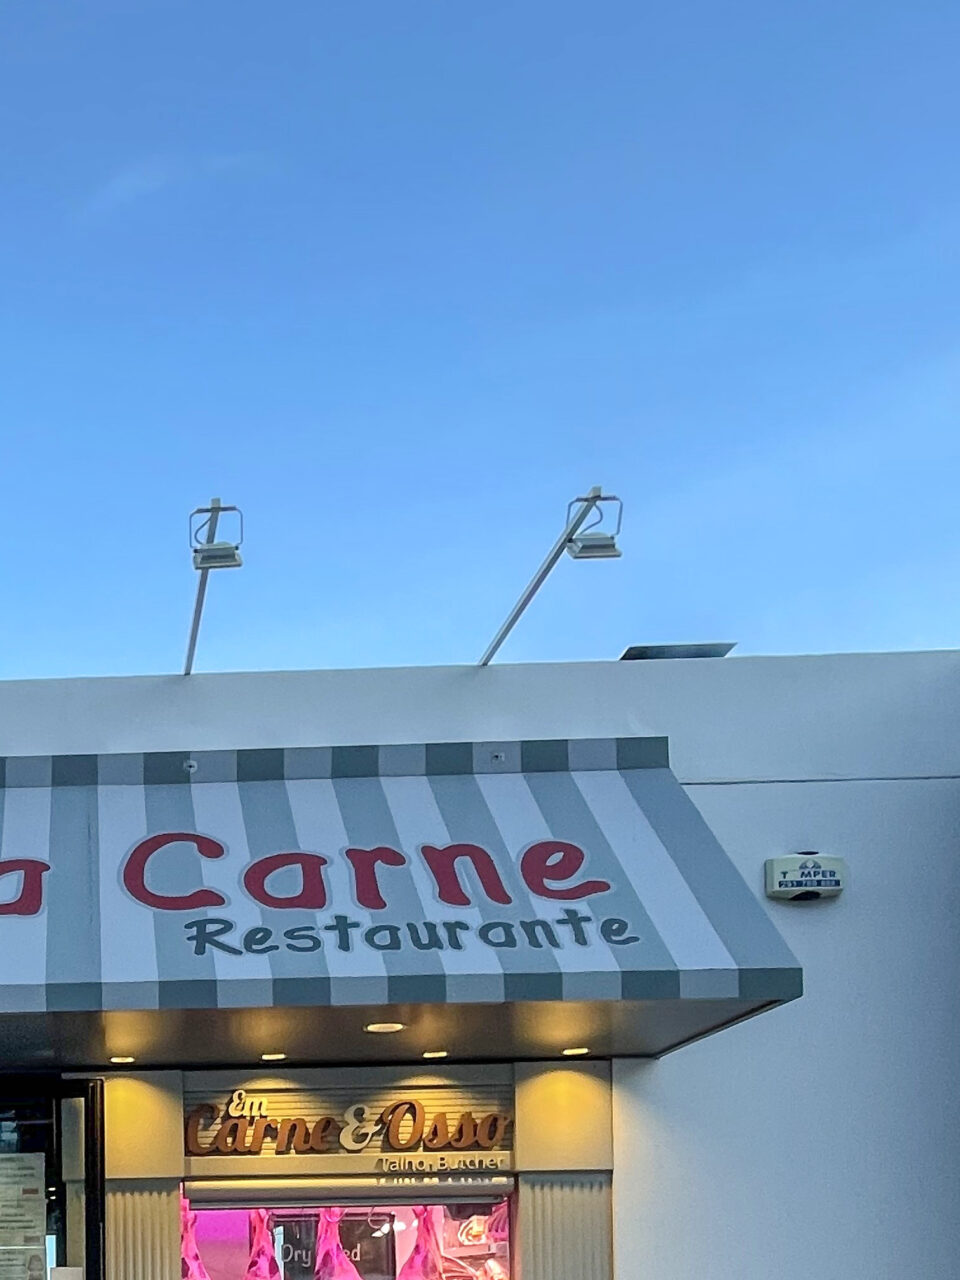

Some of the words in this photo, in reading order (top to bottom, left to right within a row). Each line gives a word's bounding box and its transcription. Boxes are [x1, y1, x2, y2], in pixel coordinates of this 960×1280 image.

[123, 832, 610, 911] Carne
[185, 908, 640, 956] Restaurante
[228, 1090, 269, 1117] Em
[187, 1102, 340, 1153] Carne
[340, 1104, 382, 1150] &
[384, 1099, 513, 1149] Osso
[438, 1153, 504, 1170] Butcher
[282, 1243, 311, 1268] Dry
